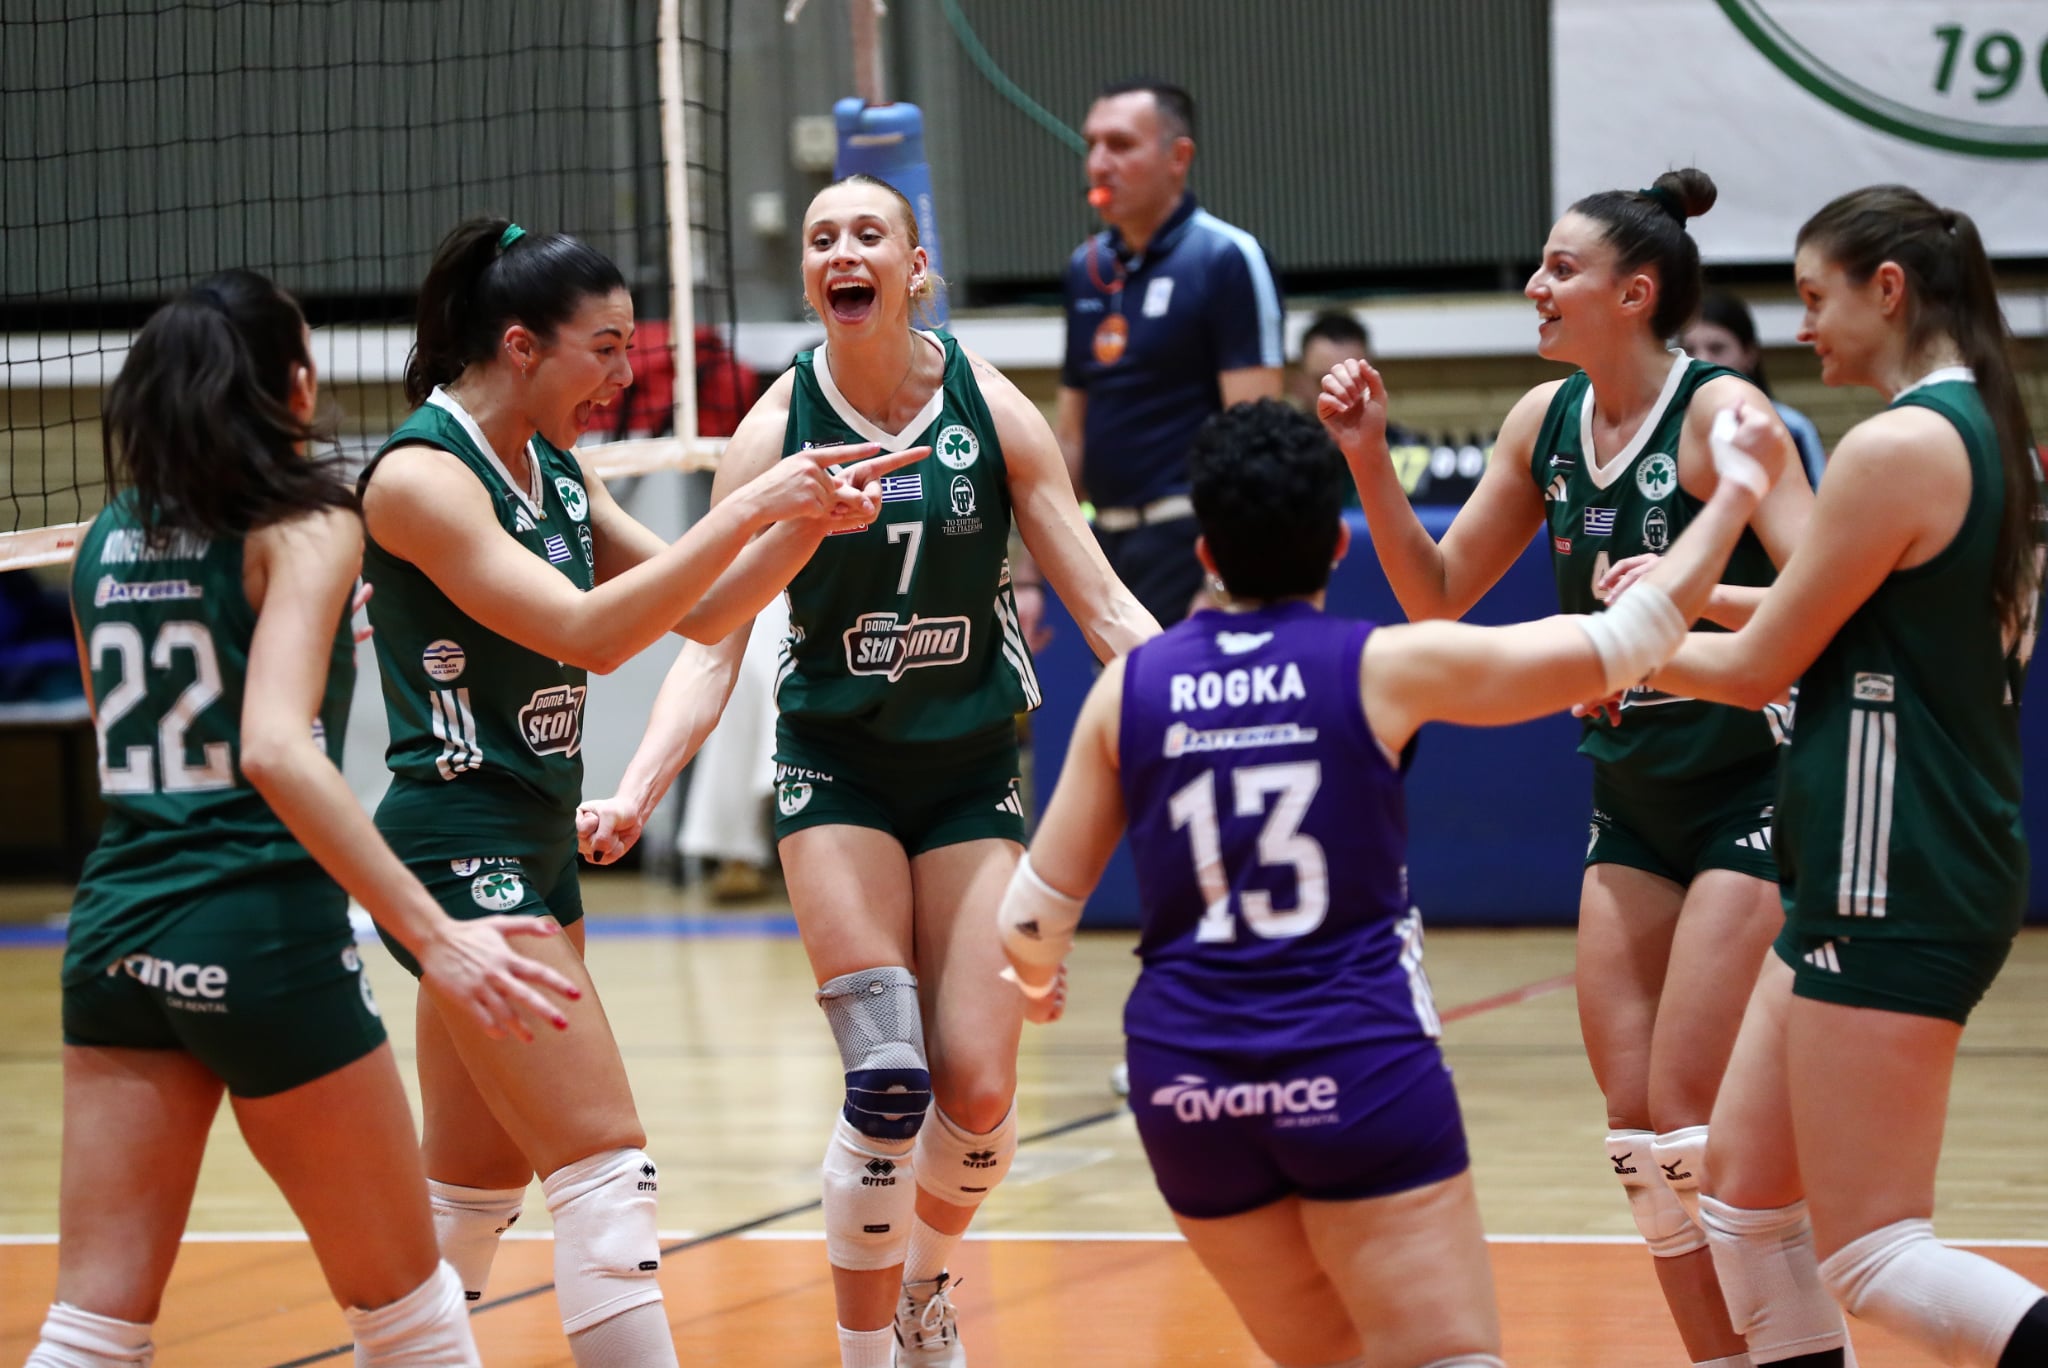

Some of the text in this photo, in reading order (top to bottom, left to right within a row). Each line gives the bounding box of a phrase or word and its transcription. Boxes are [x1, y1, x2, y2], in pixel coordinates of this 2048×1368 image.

[1932, 22, 2048, 105] 19
[887, 521, 923, 595] 7
[864, 620, 893, 633] pame
[89, 620, 236, 794] 22
[535, 693, 564, 710] pame
[1170, 662, 1306, 713] ROGKA
[1168, 759, 1331, 942] 13
[1175, 1076, 1338, 1123] avance
[862, 1176, 896, 1187] errea
